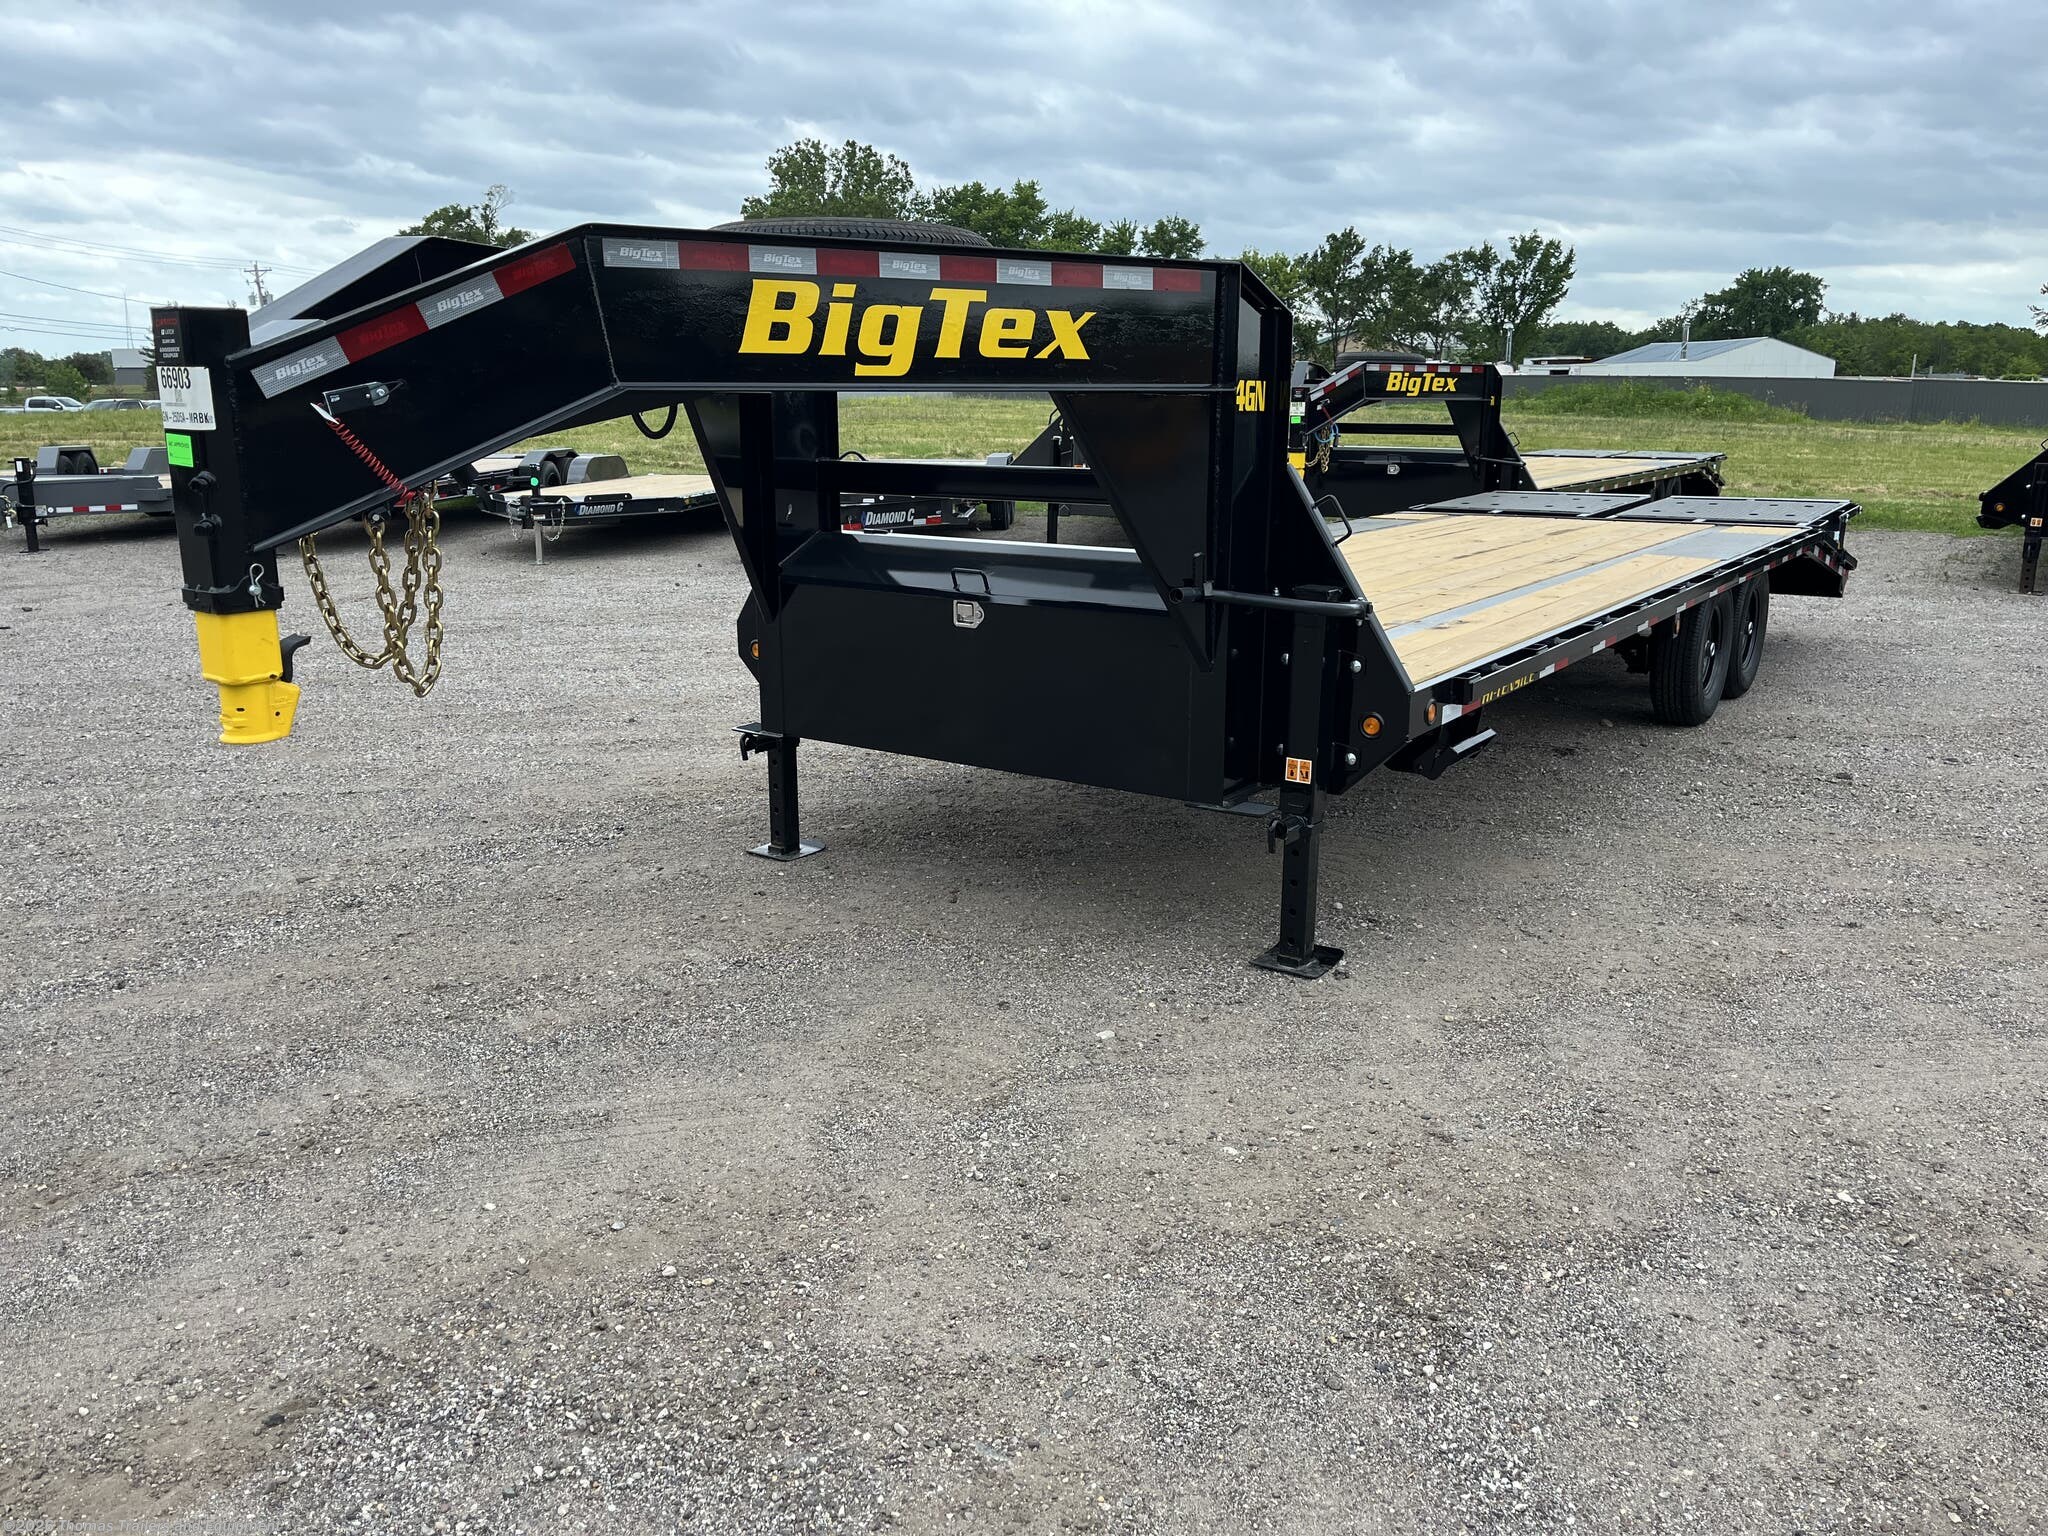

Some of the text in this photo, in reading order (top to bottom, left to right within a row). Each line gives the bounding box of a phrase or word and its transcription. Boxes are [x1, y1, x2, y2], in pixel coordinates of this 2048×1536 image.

[620, 247, 664, 259] BigTex
[763, 253, 802, 265] BigTex
[892, 260, 927, 271] BigTex
[1008, 266, 1040, 276] BigTex
[437, 287, 482, 312] BigTex
[738, 278, 1097, 376] BigTex
[275, 354, 325, 380] BigTex
[161, 367, 191, 389] 66903
[1386, 372, 1458, 397] BigTex
[579, 502, 624, 516] DIAMOND C
[865, 508, 915, 526] DIAMOND C
